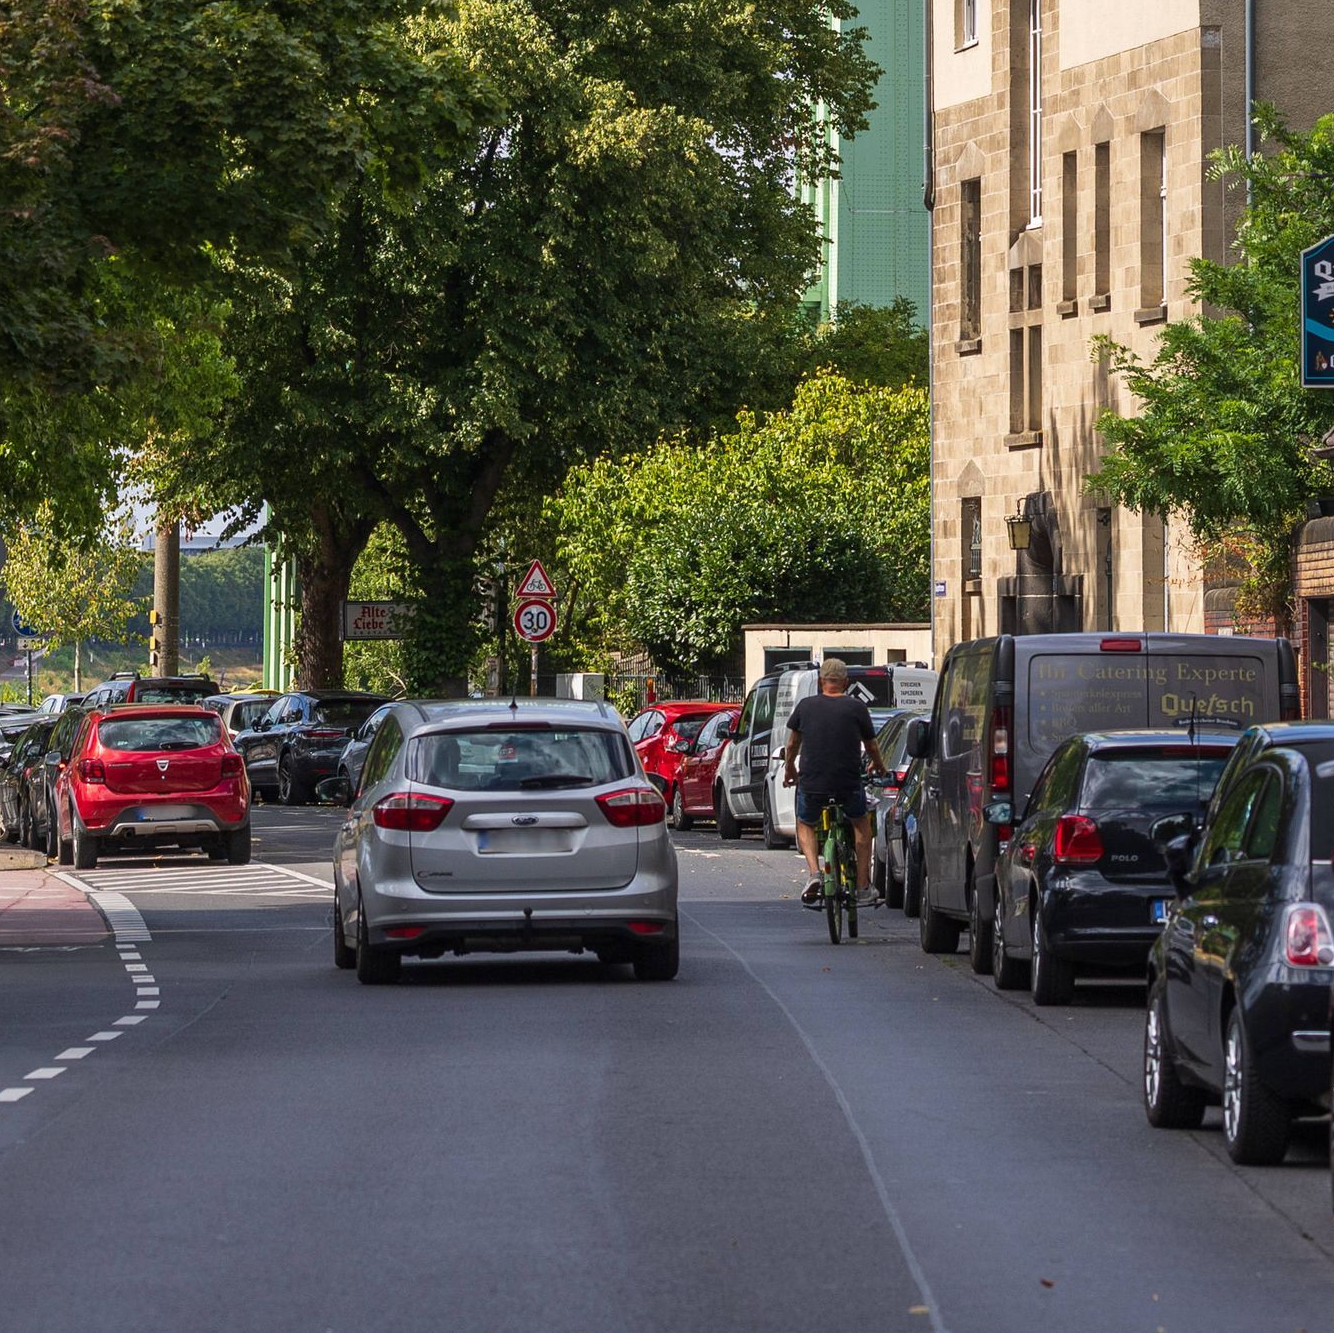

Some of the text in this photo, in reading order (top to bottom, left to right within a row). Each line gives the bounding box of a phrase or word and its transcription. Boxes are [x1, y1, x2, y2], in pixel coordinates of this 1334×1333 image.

[361, 606, 388, 618] Alte
[353, 618, 385, 630] Liebe
[523, 611, 548, 629] 30
[1077, 662, 1167, 685] Catering
[1178, 662, 1256, 686] Experte
[1161, 693, 1254, 717] Quetsch
[1111, 854, 1139, 862] POLO
